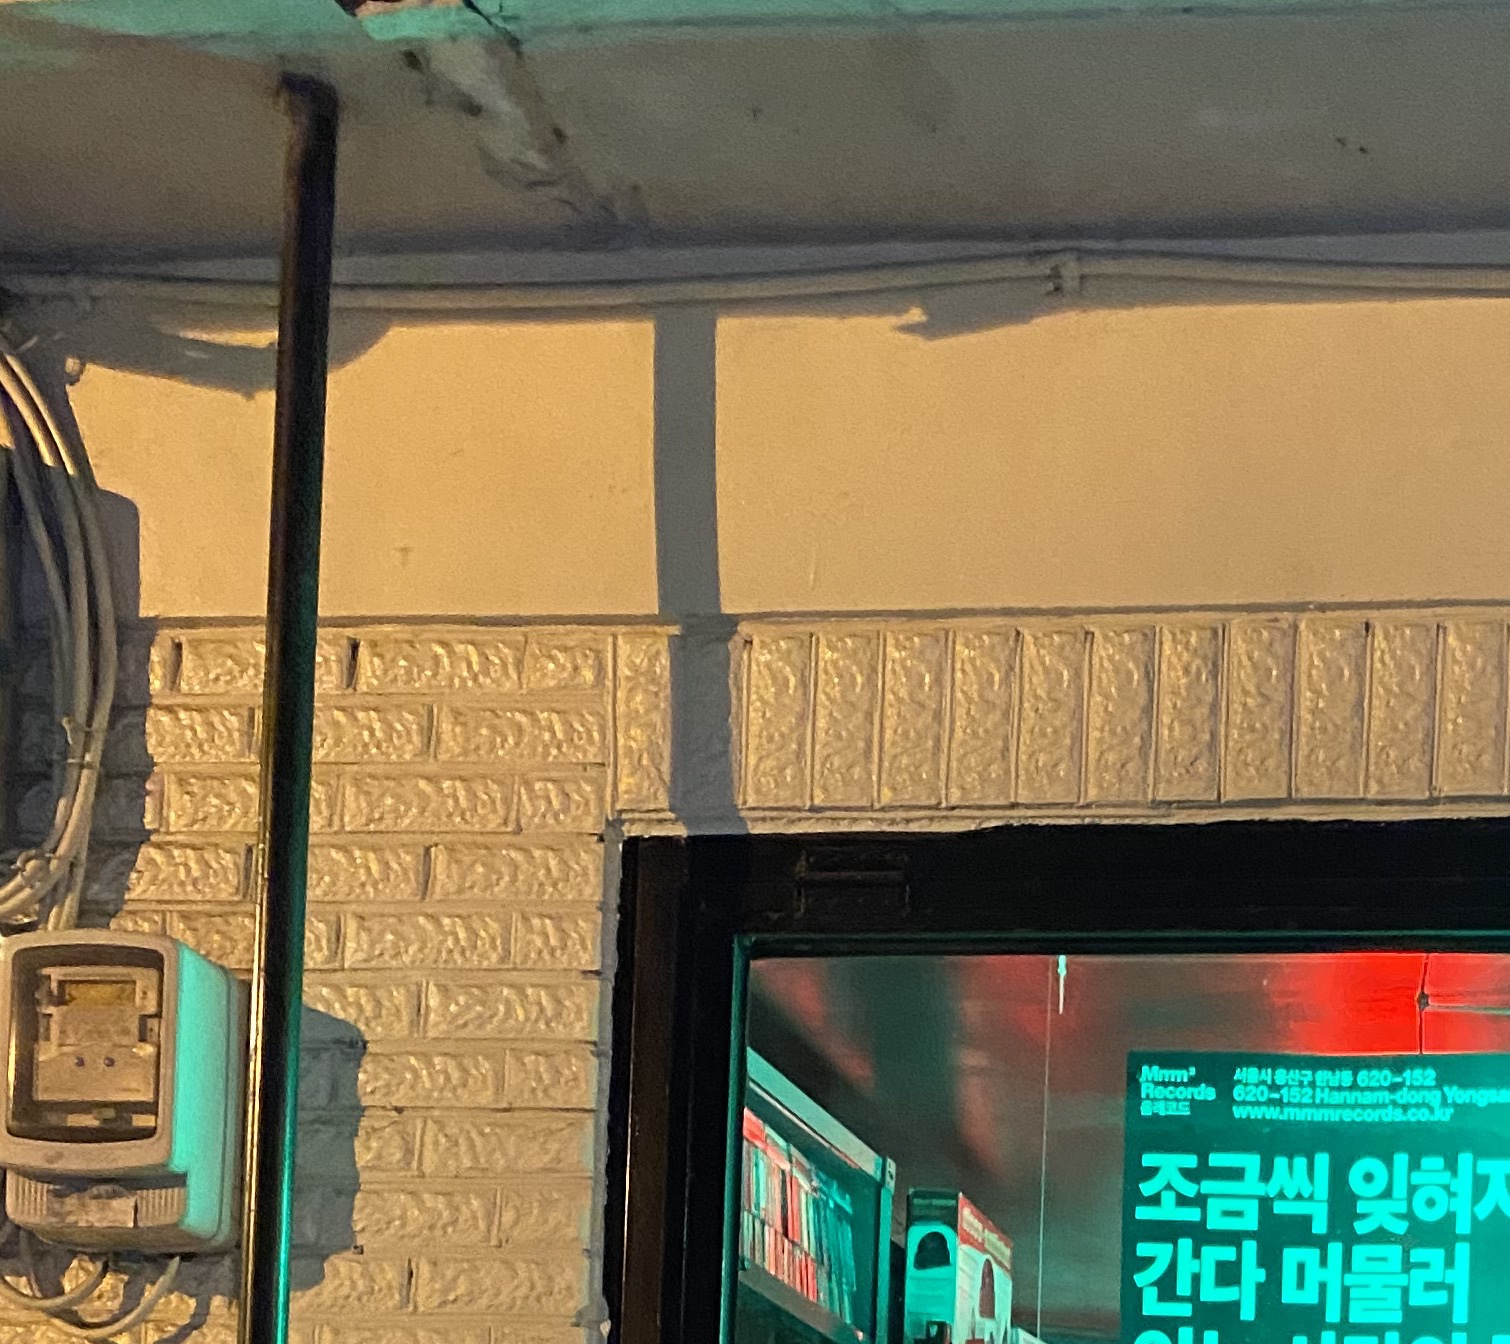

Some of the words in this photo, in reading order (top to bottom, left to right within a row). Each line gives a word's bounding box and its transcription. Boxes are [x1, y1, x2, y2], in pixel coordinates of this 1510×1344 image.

[1356, 1069, 1437, 1087] 620-152
[1141, 1083, 1216, 1100] Records
[1233, 1086, 1313, 1103] 620-152
[1315, 1087, 1441, 1107] Hannam-dong
[1135, 1153, 1330, 1234] 조금씩
[1133, 1238, 1266, 1321] 간다
[1281, 1241, 1471, 1324] 머물러
